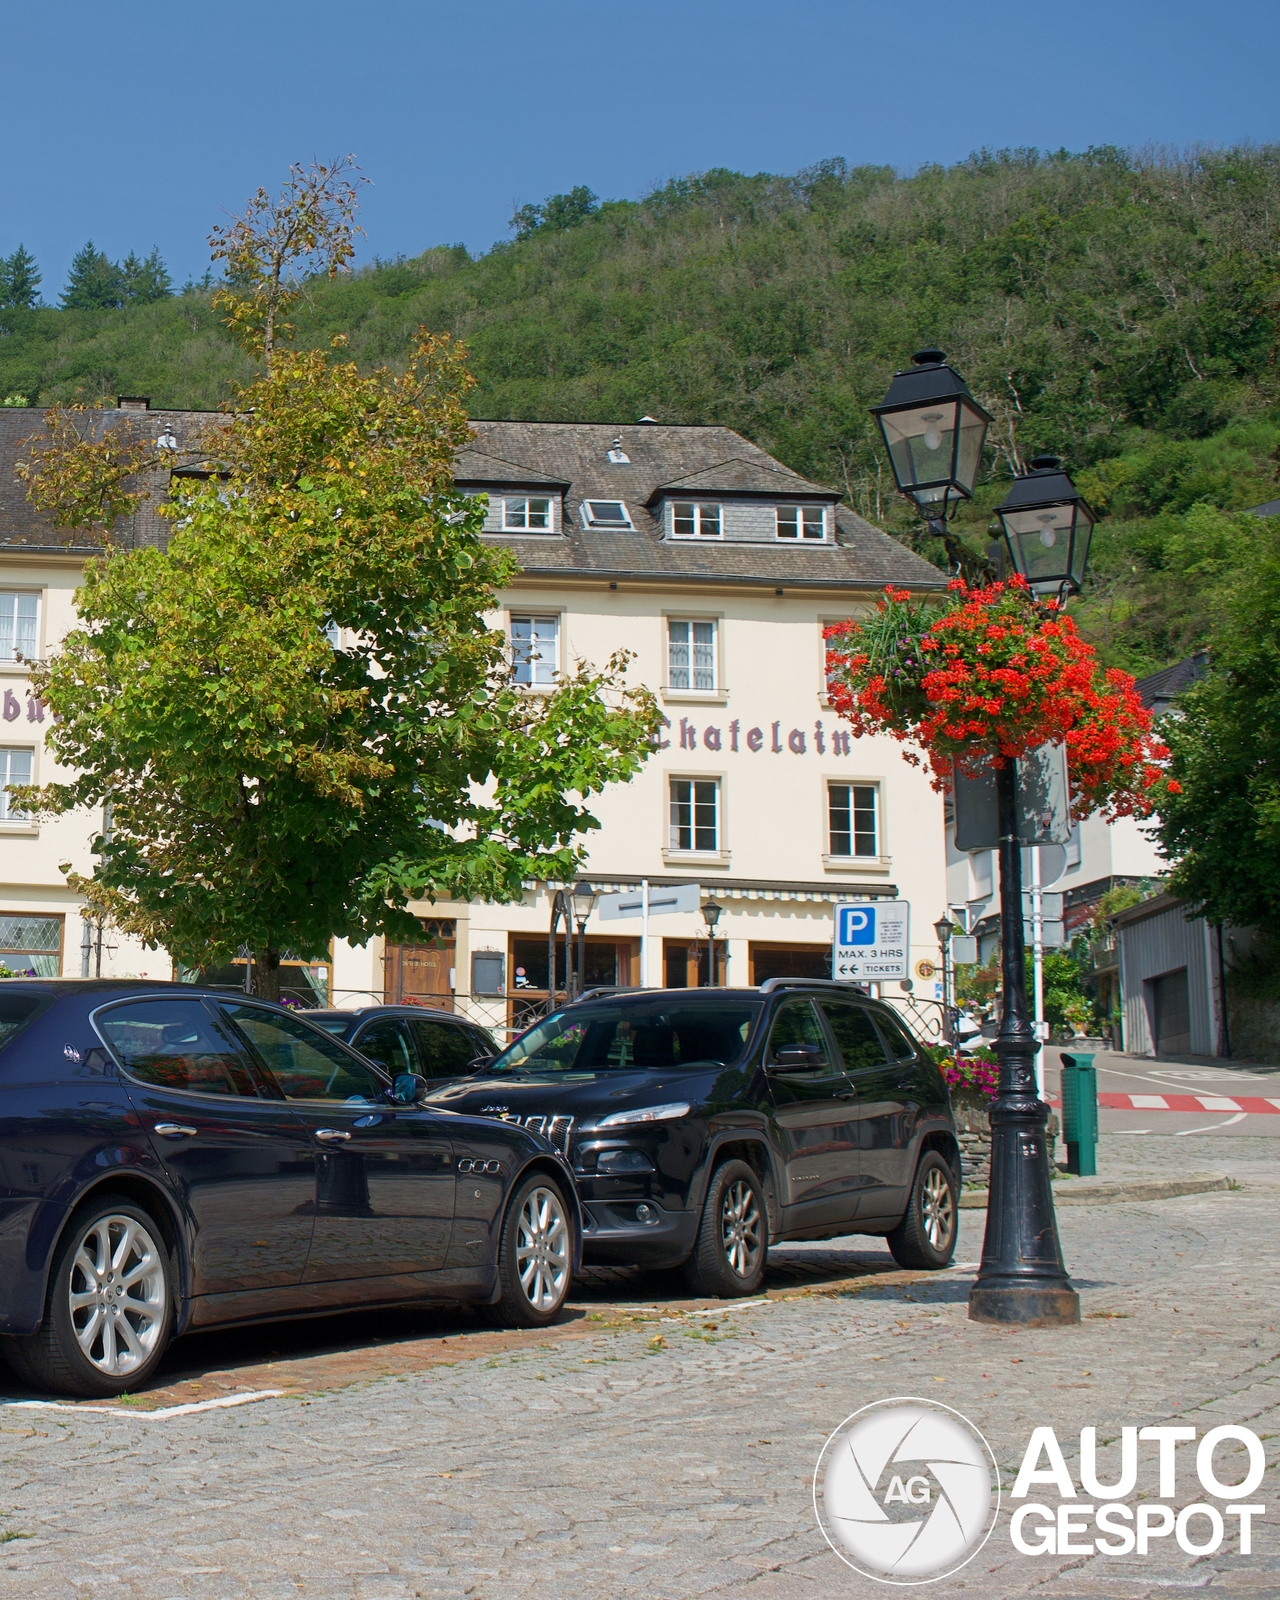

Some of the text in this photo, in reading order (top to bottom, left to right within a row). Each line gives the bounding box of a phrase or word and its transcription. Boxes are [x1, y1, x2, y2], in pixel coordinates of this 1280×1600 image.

[846, 911, 868, 943] P
[838, 949, 903, 958] MAX. 3 HRS
